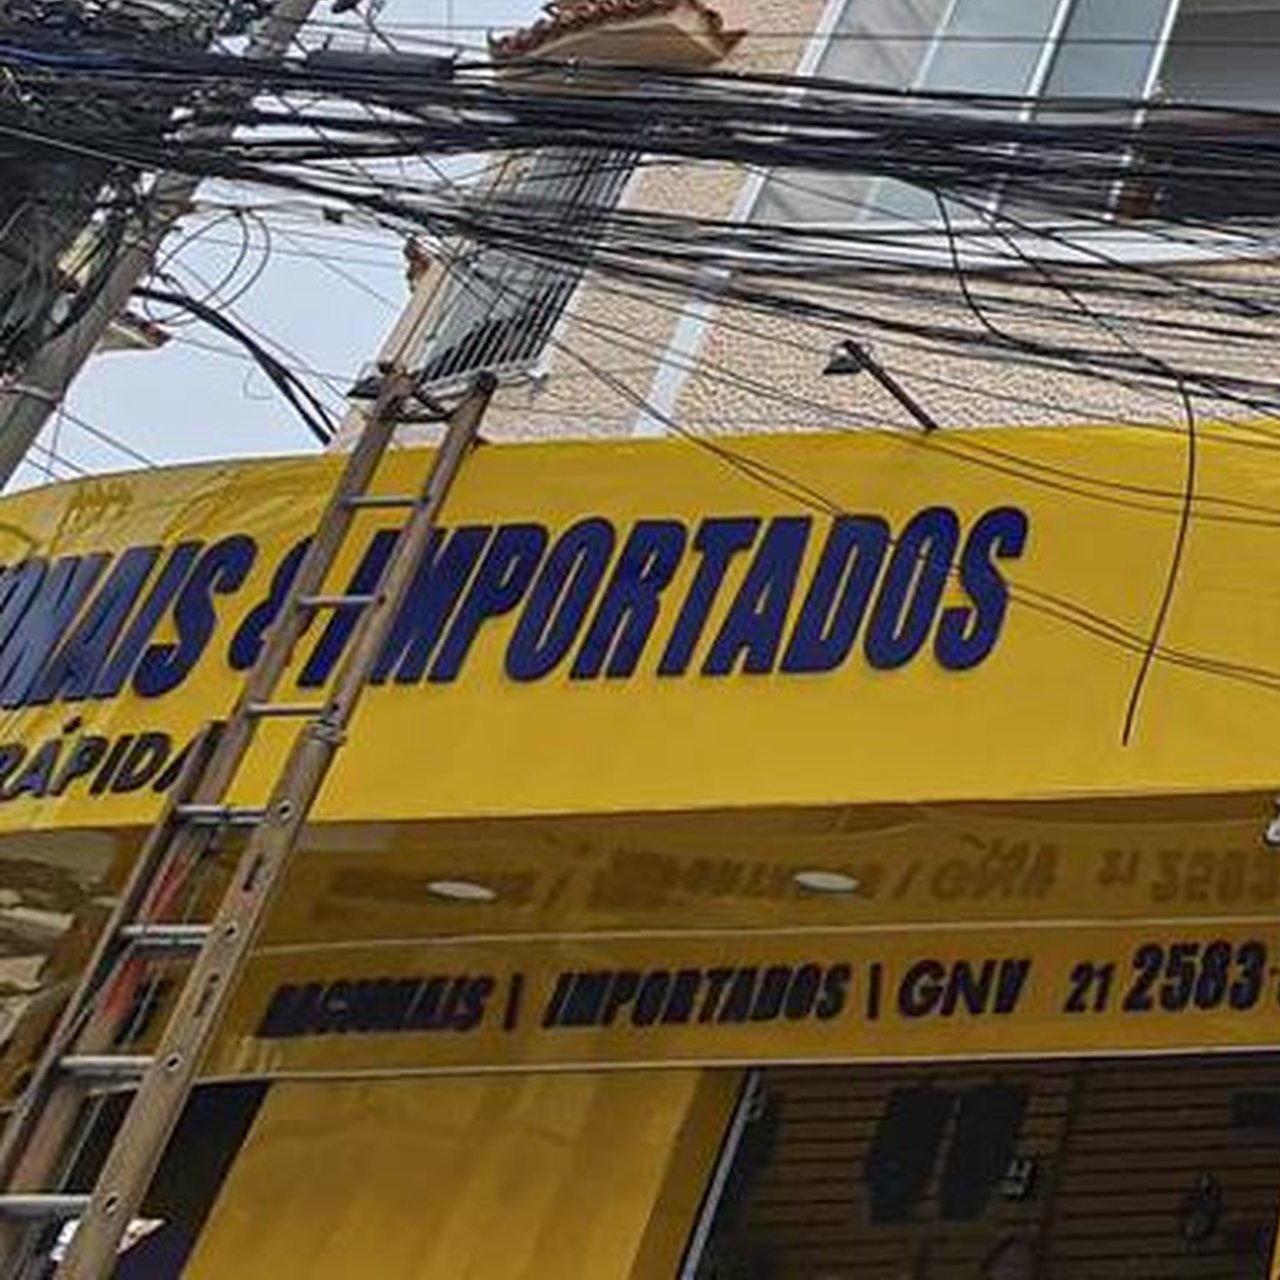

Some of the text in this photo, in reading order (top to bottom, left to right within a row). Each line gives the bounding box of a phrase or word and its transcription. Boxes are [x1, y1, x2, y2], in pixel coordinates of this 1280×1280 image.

[296, 506, 1028, 688] IMPORTADOS
[541, 962, 851, 1030] IMPORTADOS
[898, 958, 1035, 1018] GNV
[1062, 960, 1116, 1014] 21
